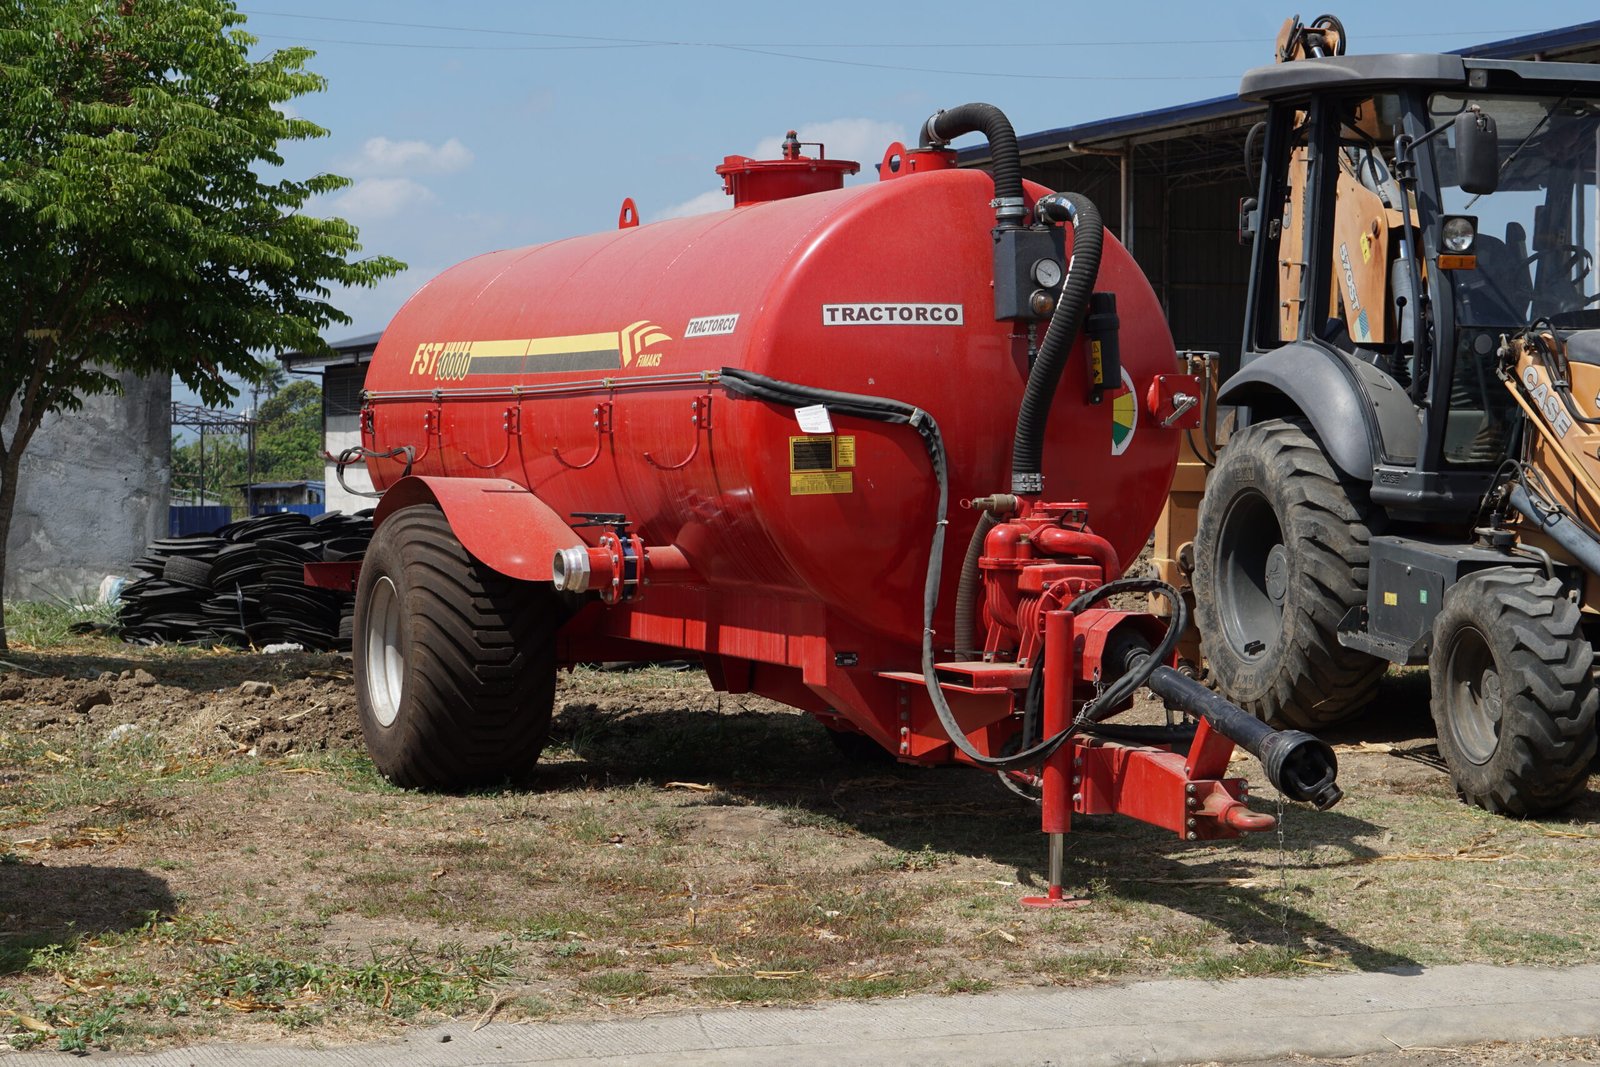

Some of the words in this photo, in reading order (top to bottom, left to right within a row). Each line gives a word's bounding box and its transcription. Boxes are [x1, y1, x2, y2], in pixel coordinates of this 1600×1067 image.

[687, 317, 736, 335] TRACTORCO
[826, 306, 959, 322] TRACTORCO
[409, 342, 445, 375] FST
[1522, 365, 1572, 439] CASE
